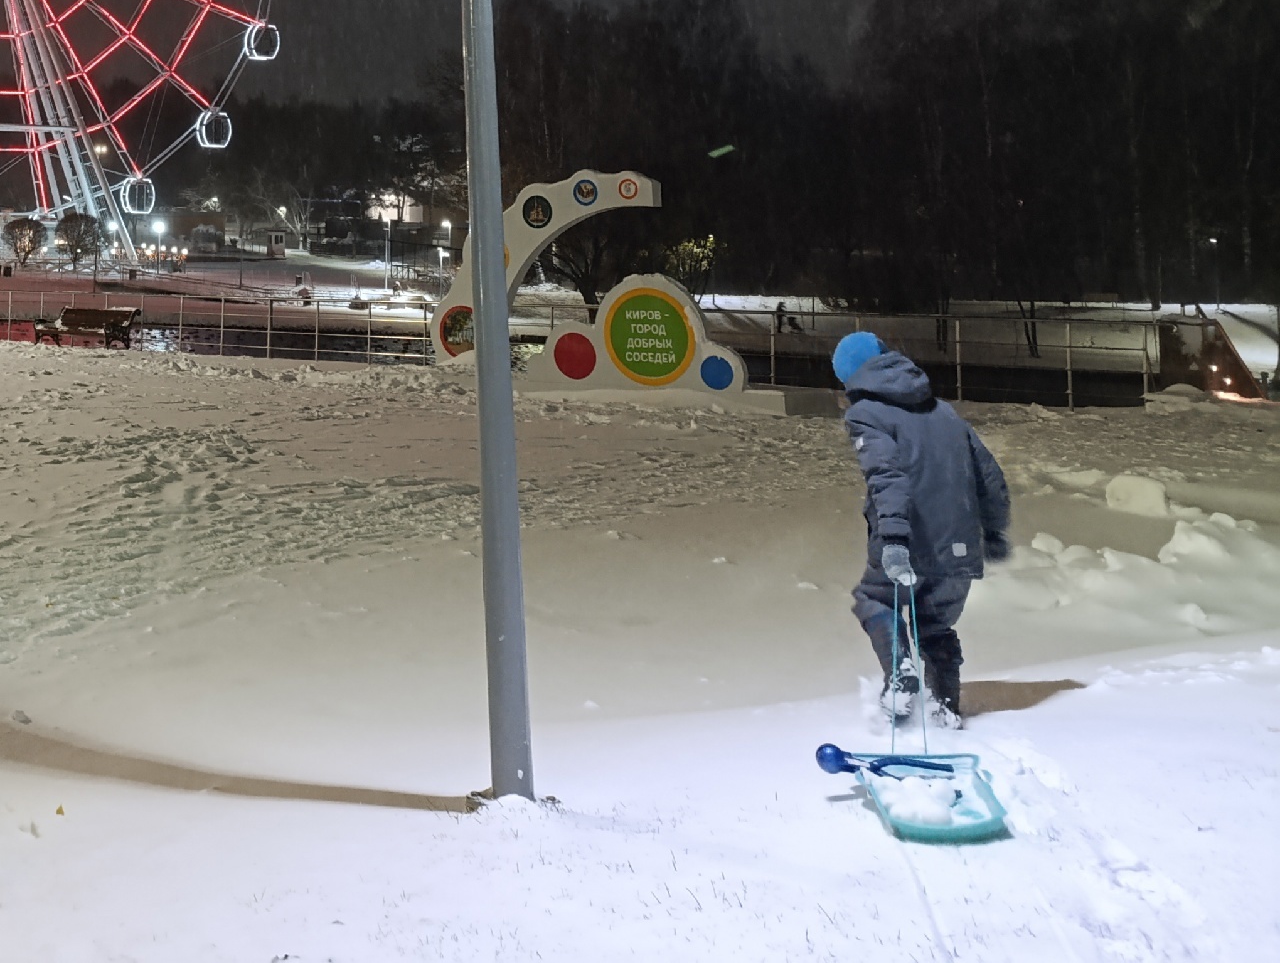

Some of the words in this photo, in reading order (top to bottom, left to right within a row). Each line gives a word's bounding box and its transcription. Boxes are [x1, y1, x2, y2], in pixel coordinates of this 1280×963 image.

[625, 310, 661, 320] КИРОВ
[630, 323, 667, 336] ГОРОД
[626, 338, 673, 350] ДОБРЫХ
[625, 351, 676, 365] СОСЕДЕЙ
